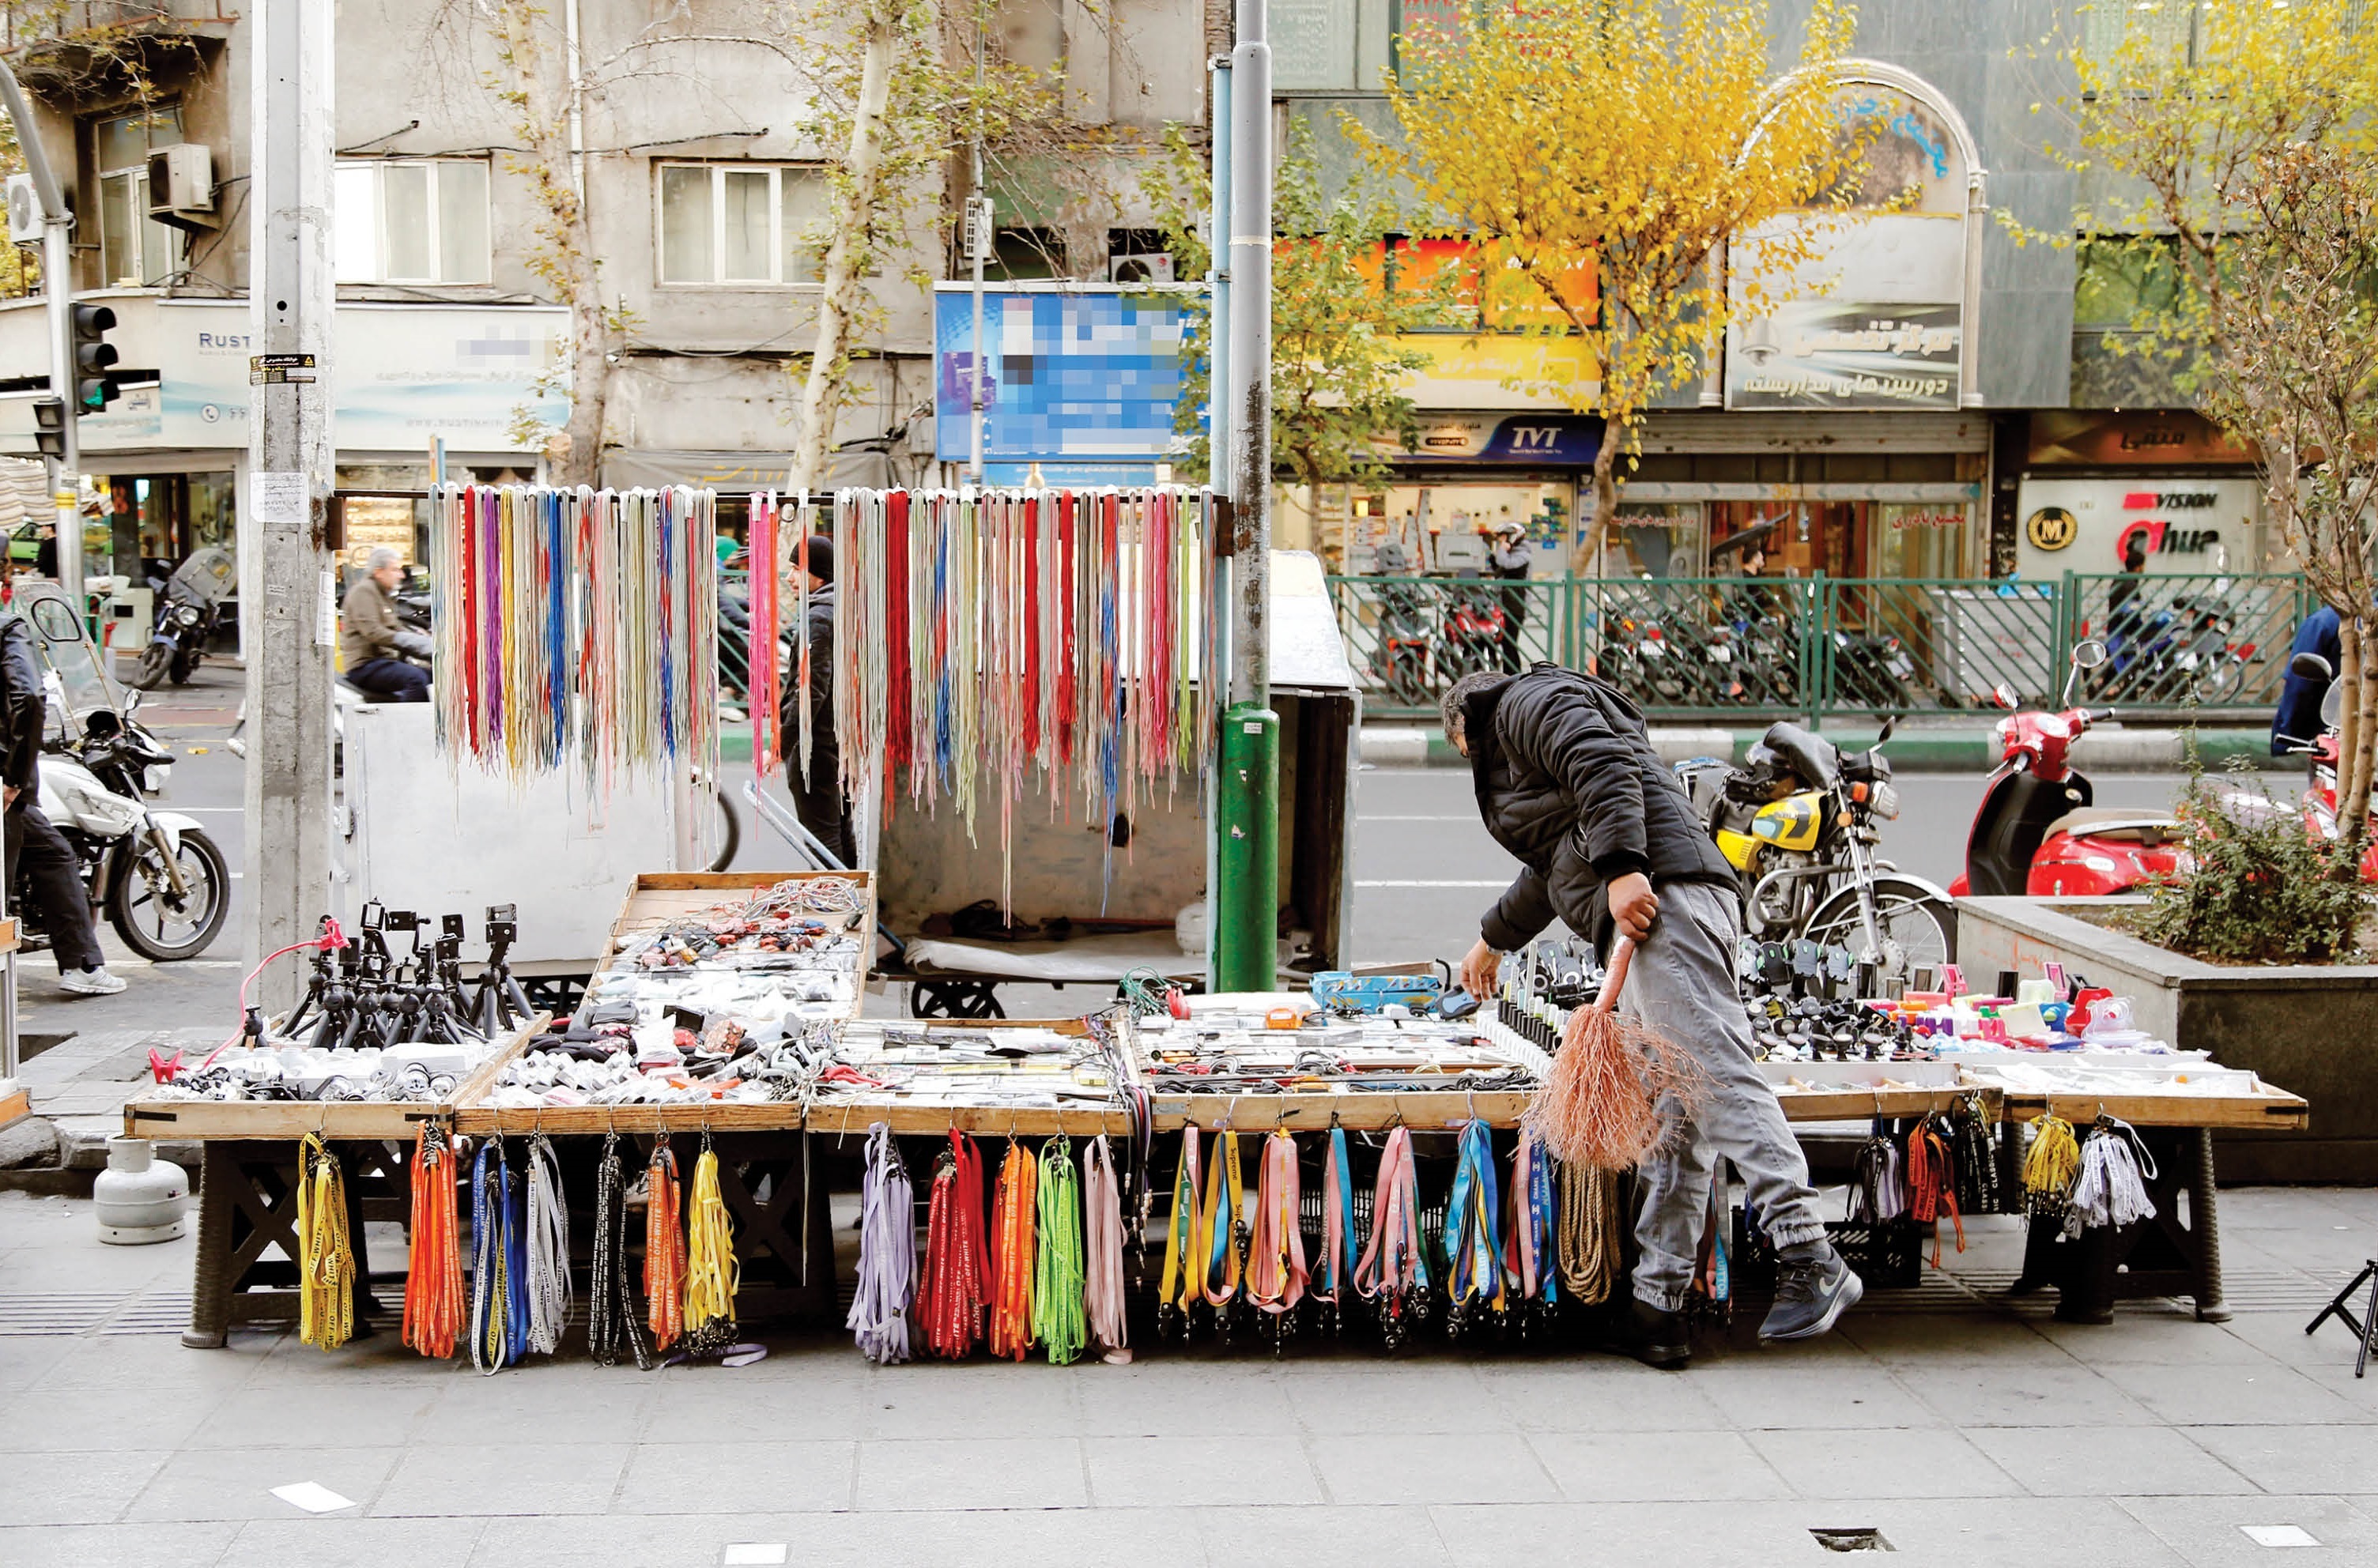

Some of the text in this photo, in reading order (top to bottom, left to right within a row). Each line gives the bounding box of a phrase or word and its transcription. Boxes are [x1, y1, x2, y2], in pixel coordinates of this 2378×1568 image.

[1792, 320, 1954, 358] مرکز تخصصی
[1743, 373, 1950, 400] دوربین های مداربسته
[1512, 428, 1563, 449] TVT
[2041, 518, 2063, 541] M
[1229, 1147, 1238, 1181] Supreme
[309, 1227, 323, 1273] OFF-WHITE
[1717, 1254, 1727, 1298] VUITTON
